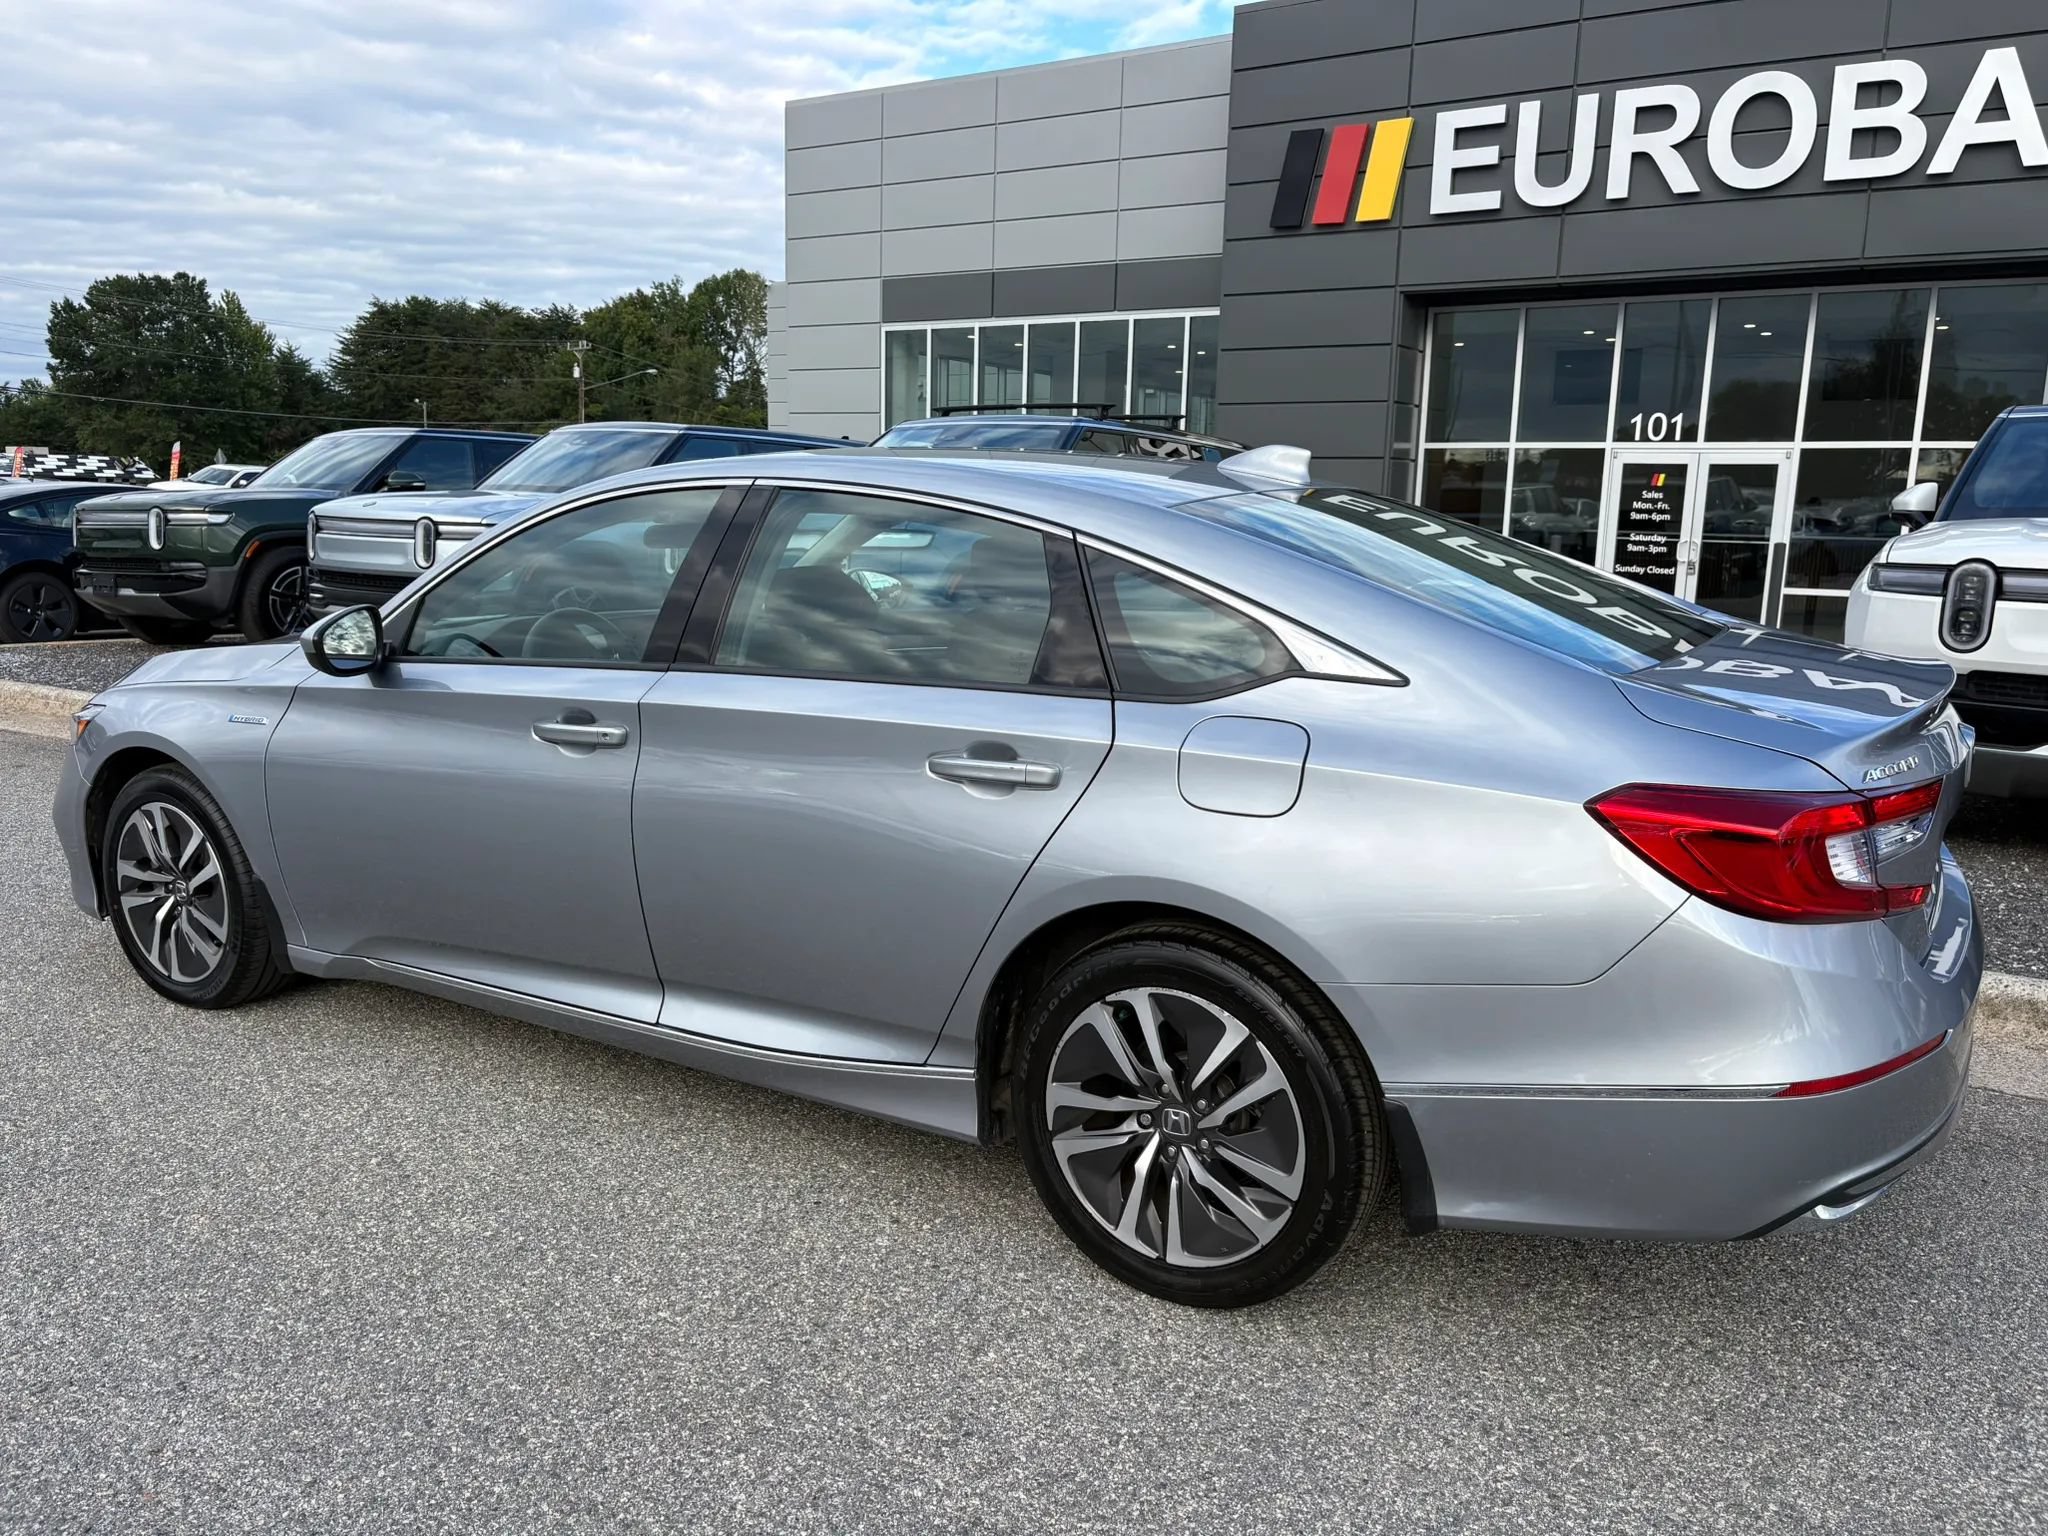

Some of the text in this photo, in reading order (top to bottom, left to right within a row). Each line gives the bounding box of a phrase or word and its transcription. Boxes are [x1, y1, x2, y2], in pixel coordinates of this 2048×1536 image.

[1429, 46, 2048, 216] EUROBA
[1630, 412, 1684, 442] 101
[1641, 490, 1664, 499] Sales
[1630, 512, 1671, 523] 9am-6pm
[1629, 533, 1667, 544] Saturday
[1627, 544, 1667, 554] 9am-3pm
[1615, 564, 1675, 575] Sunday Closed
[232, 714, 266, 724] HYBRID
[1863, 755, 1919, 784] ACCORD
